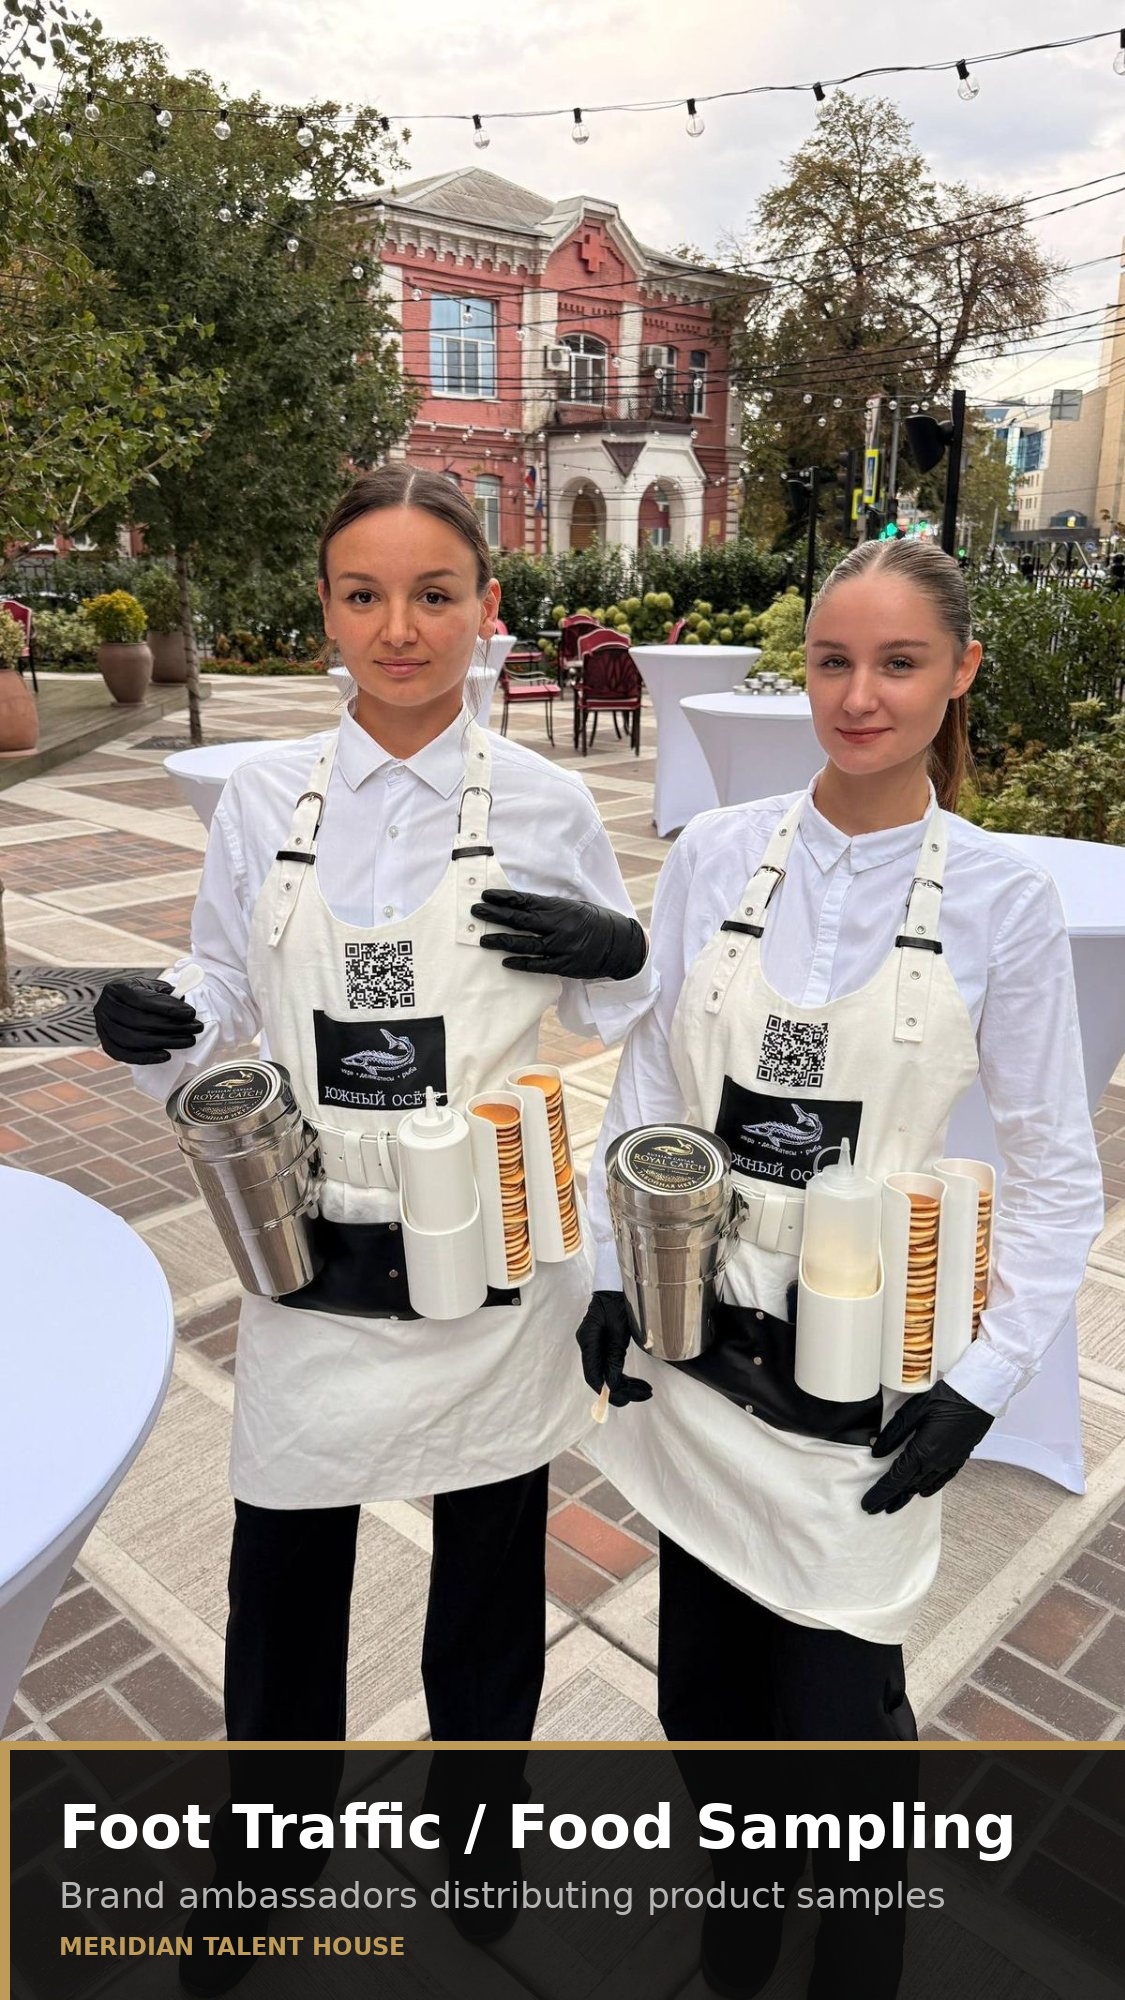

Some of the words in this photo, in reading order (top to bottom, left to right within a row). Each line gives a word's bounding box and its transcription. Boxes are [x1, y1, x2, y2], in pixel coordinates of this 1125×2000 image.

[193, 1093, 226, 1101] ROYAL
[228, 1089, 264, 1098] CATCH
[324, 1085, 386, 1106] ЮЖНЫЙ
[391, 1089, 442, 1107] ОСЁР
[634, 1153, 667, 1166] ROYAL
[669, 1159, 707, 1172] CATCH
